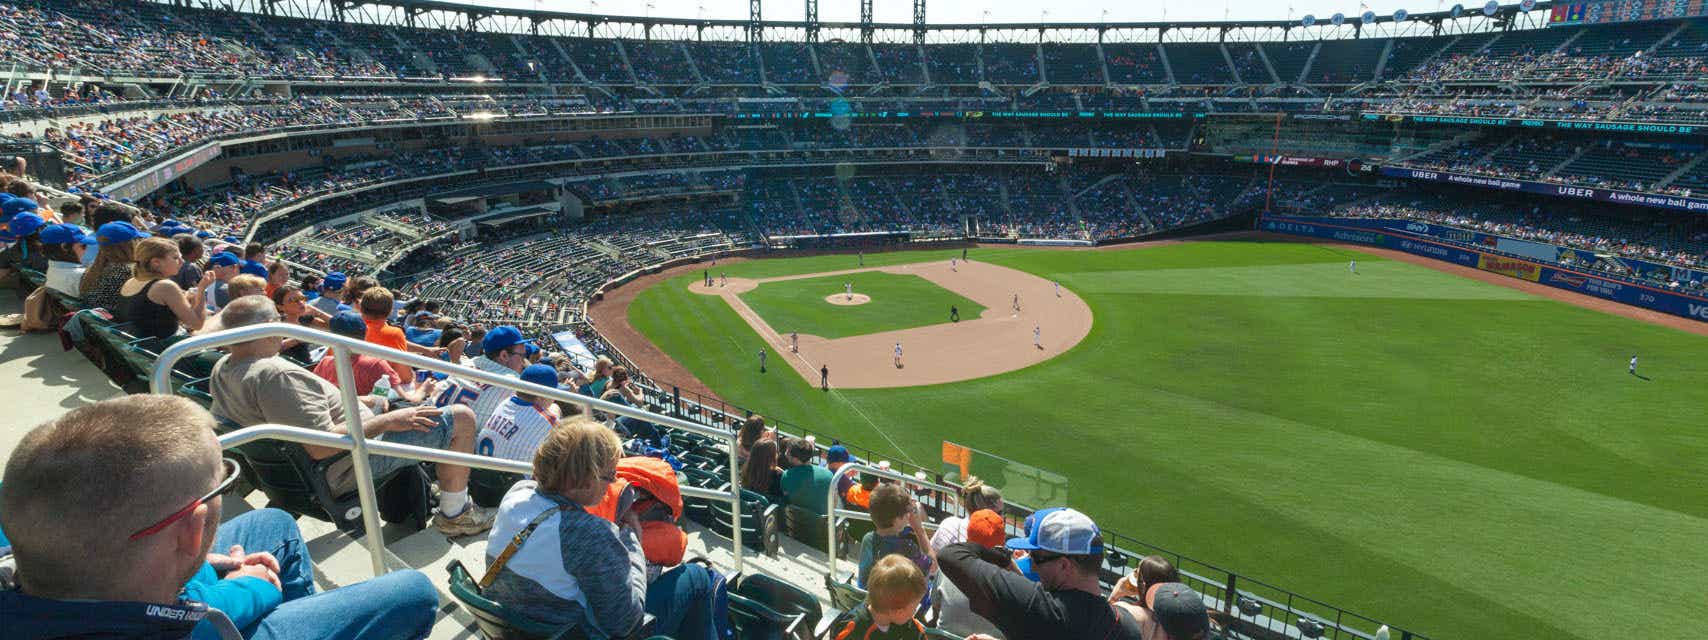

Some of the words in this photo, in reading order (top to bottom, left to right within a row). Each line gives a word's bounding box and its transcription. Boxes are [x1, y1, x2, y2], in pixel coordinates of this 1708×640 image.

[1595, 123, 1635, 131] SAUSAGE
[1638, 124, 1676, 133] SHOULD
[1412, 171, 1437, 180] UBER
[1454, 176, 1472, 184] whole
[1488, 178, 1500, 186] ball
[1501, 181, 1521, 189] game
[1558, 186, 1594, 198] UBER
[1609, 192, 1617, 200] A
[1617, 193, 1645, 203] whole
[1646, 196, 1666, 205] new
[1667, 198, 1686, 207] ball
[1280, 222, 1314, 232] DELTA
[146, 604, 185, 620] UNDER
